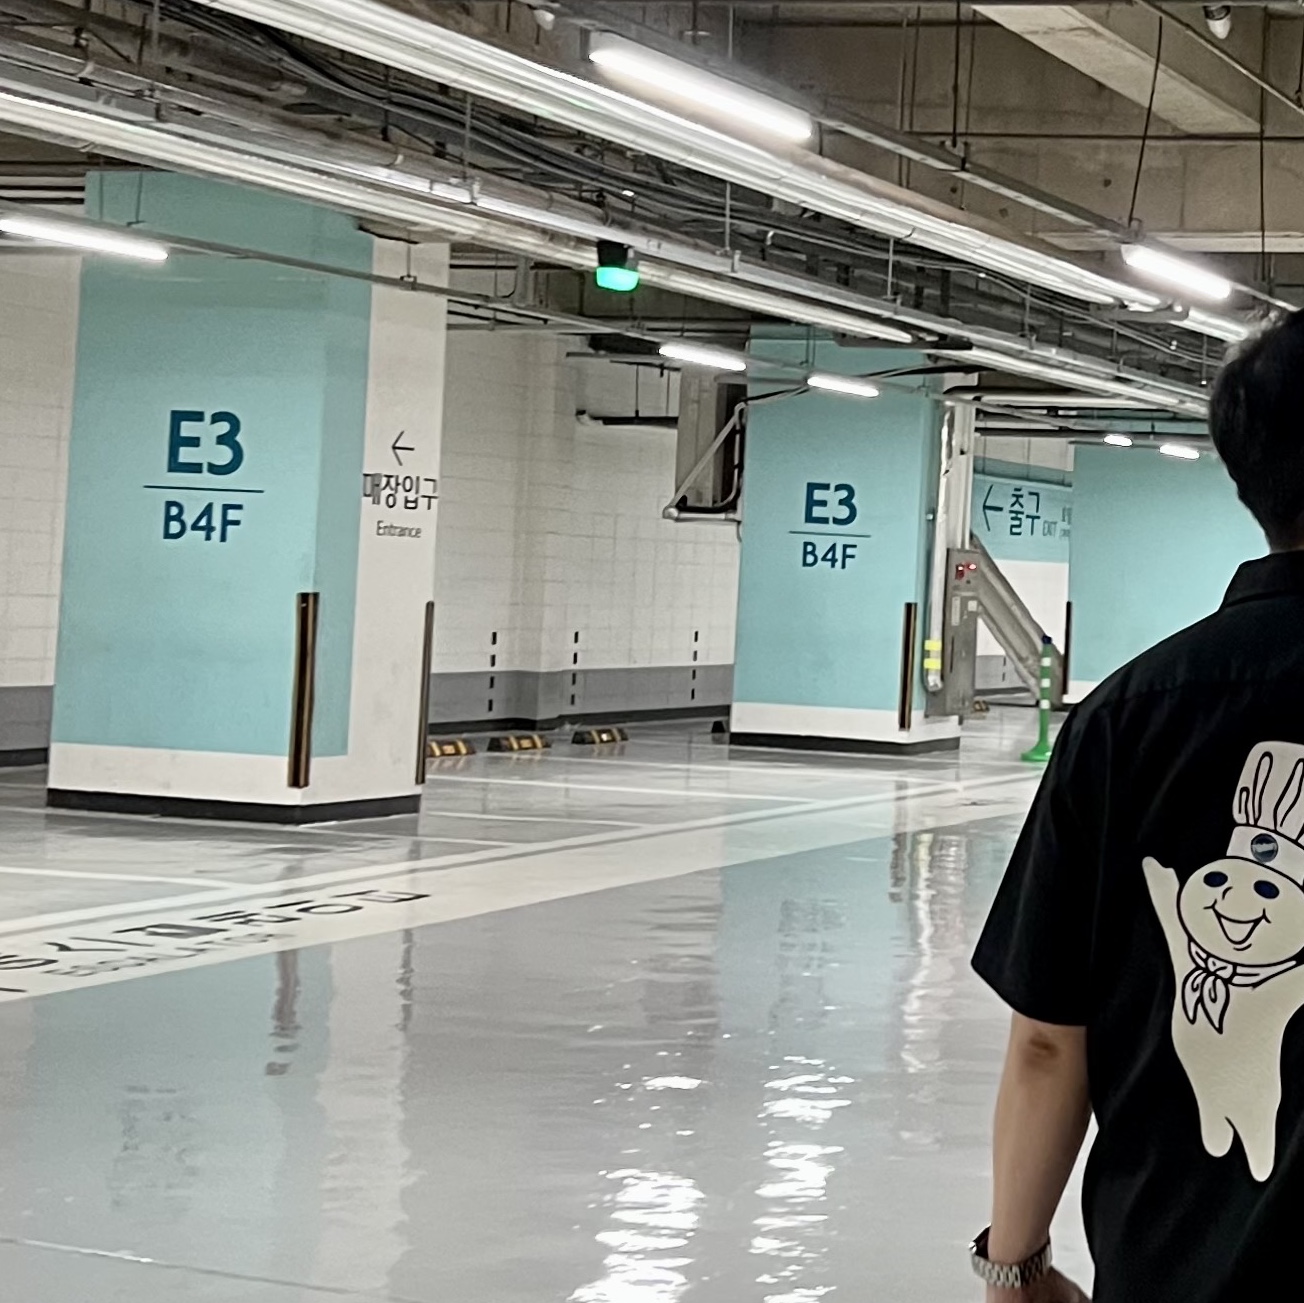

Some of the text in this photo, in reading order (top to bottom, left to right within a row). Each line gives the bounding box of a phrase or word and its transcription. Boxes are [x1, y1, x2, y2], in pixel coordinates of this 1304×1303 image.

[167, 409, 244, 476] E3
[362, 472, 440, 511] 매장입구
[804, 482, 858, 526] E3
[1009, 487, 1041, 536] 출구
[163, 500, 244, 543] B4F
[376, 520, 422, 539] Entrance
[801, 541, 858, 570] B4F
